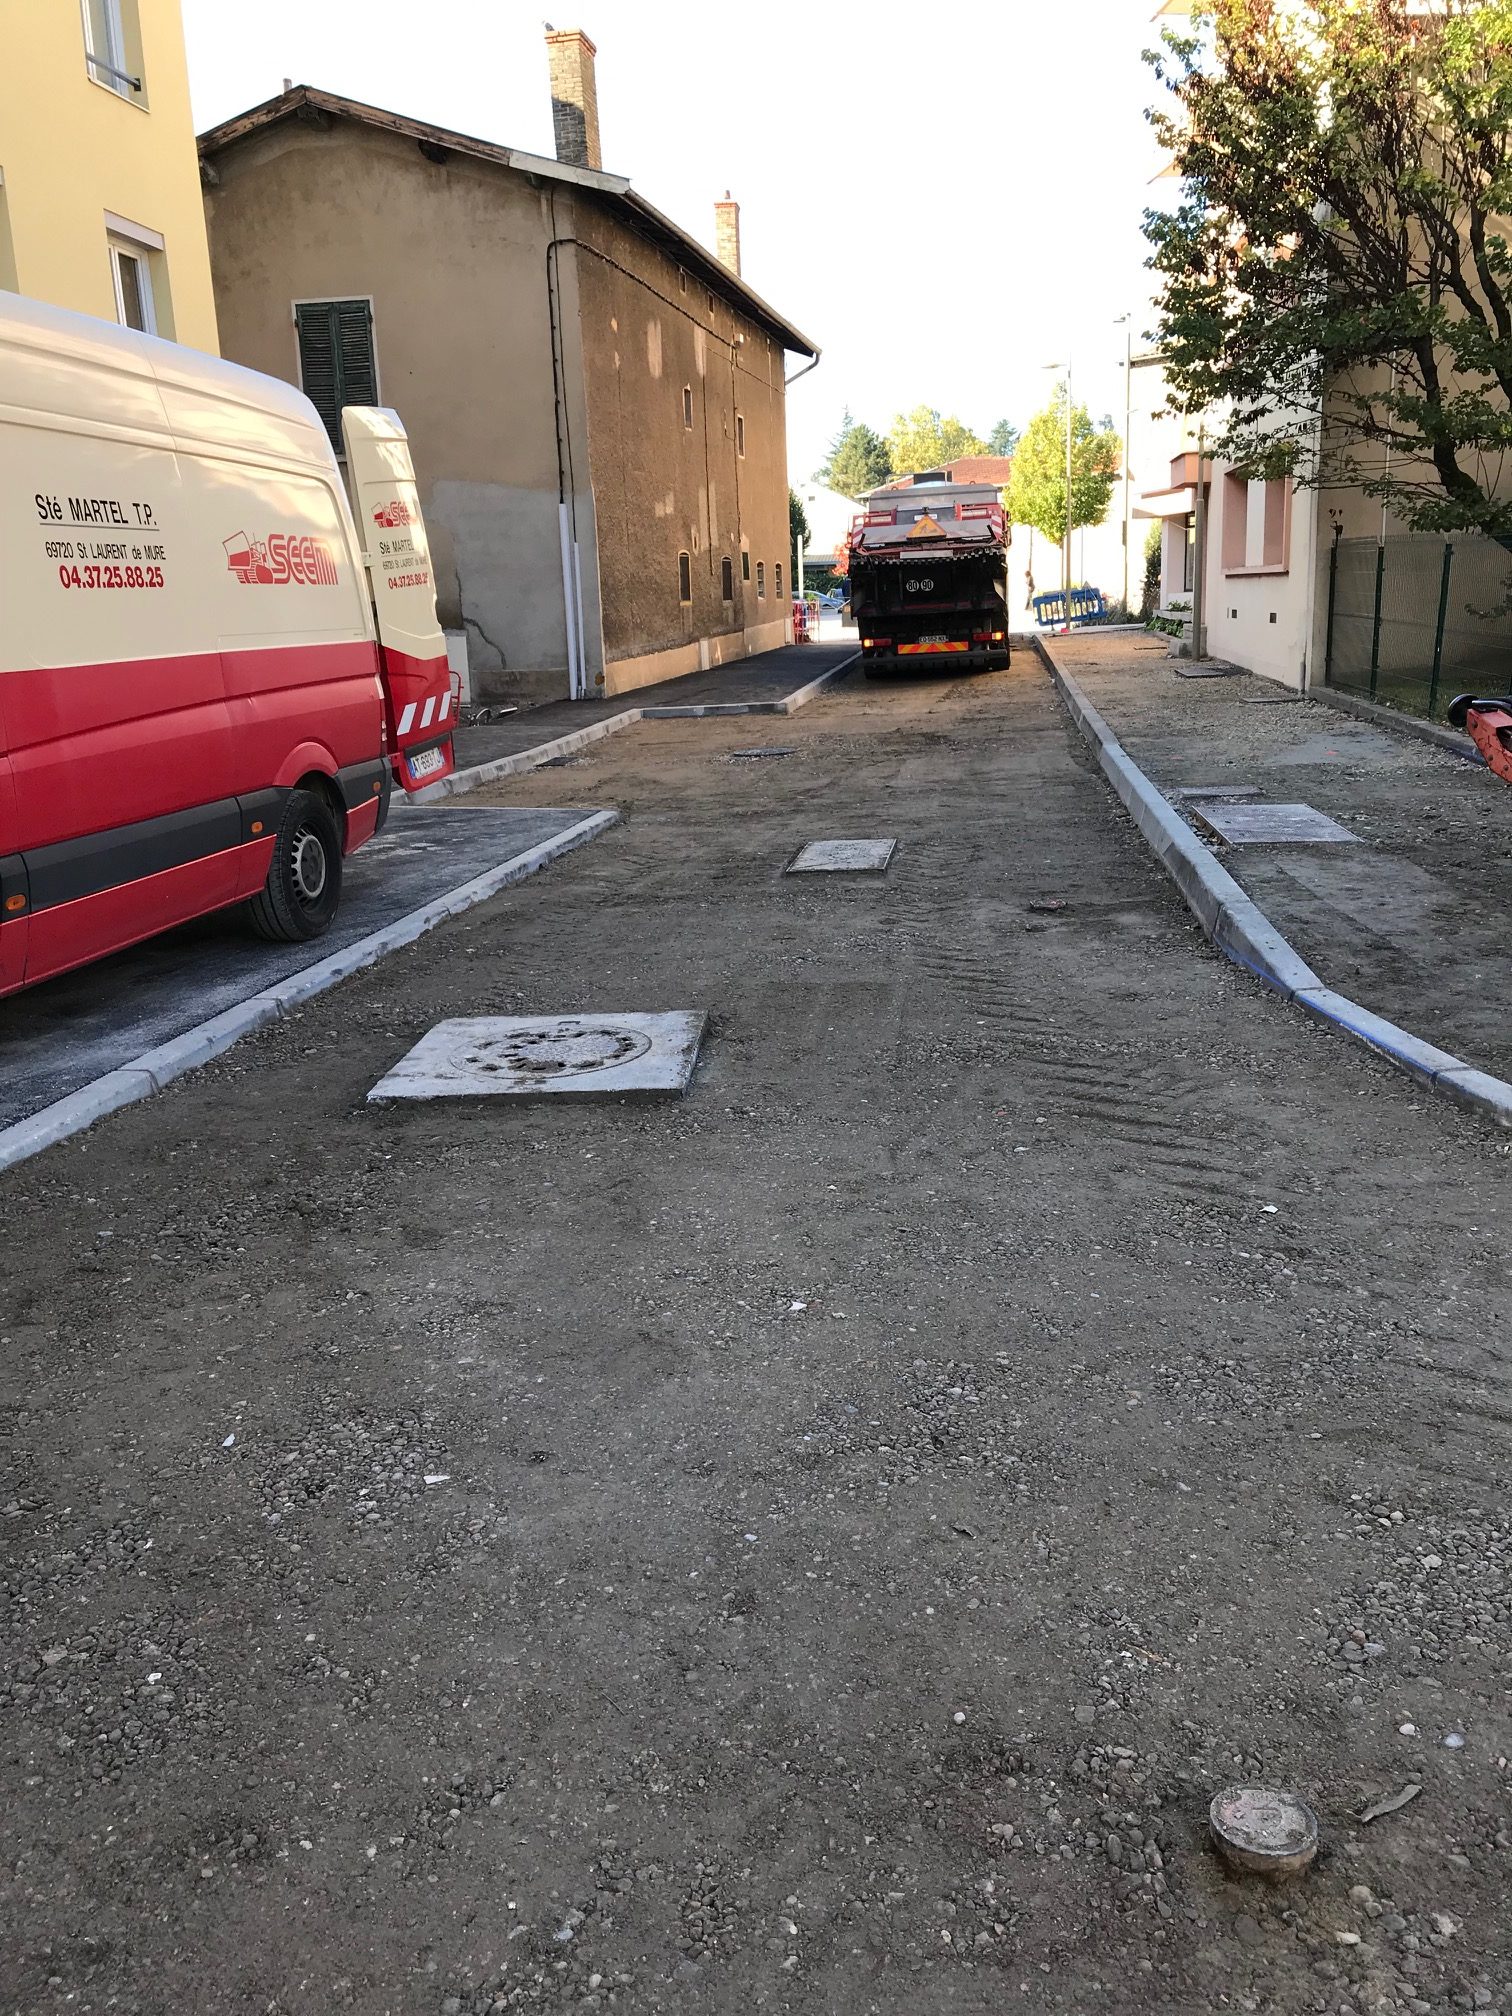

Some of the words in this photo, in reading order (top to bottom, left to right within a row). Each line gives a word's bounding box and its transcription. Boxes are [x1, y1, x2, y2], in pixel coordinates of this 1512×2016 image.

[35, 494, 63, 520] Sté
[67, 497, 129, 524] MARTEL
[132, 502, 158, 526] T.P.
[45, 541, 74, 558] 69720
[77, 542, 88, 559] St
[90, 543, 128, 560] LAURENT
[132, 545, 142, 560] de
[143, 545, 166, 561] MURE
[392, 540, 414, 552] MARTEL
[59, 565, 164, 589] 04.37.25.88.25
[908, 581, 918, 591] 80
[922, 580, 932, 591] 90
